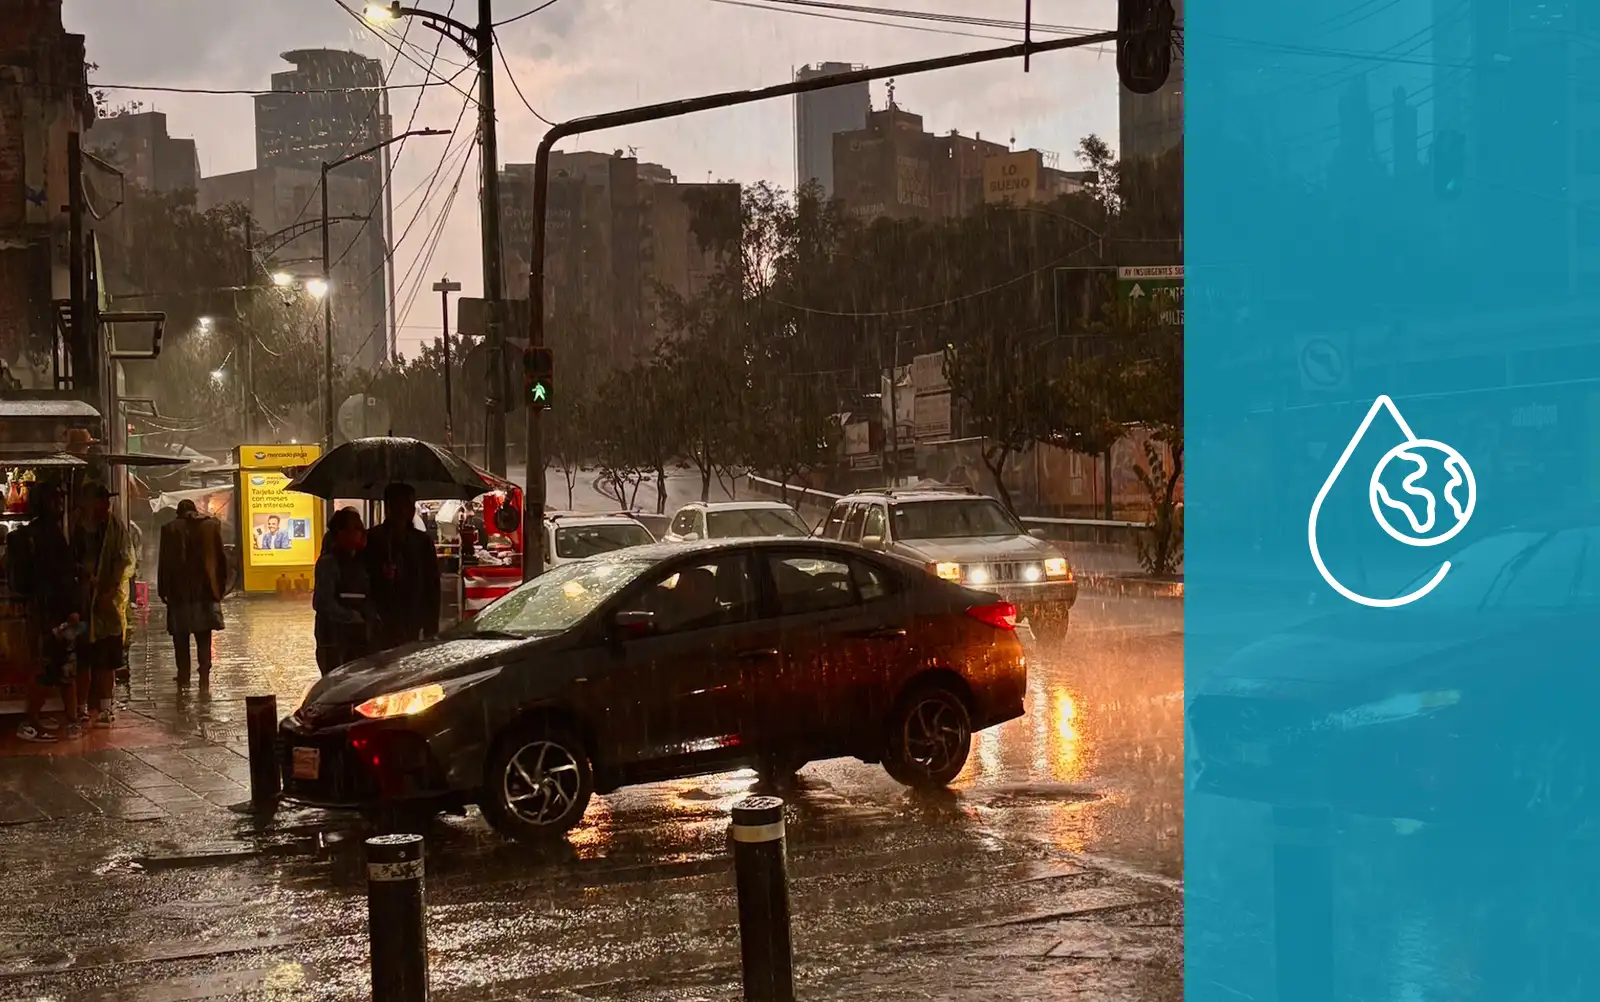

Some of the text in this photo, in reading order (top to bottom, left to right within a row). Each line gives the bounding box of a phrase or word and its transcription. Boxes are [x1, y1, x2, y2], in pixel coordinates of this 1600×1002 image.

[1002, 164, 1017, 176] LO
[990, 178, 1030, 192] BUENO
[1133, 267, 1173, 276] INSURGENTES
